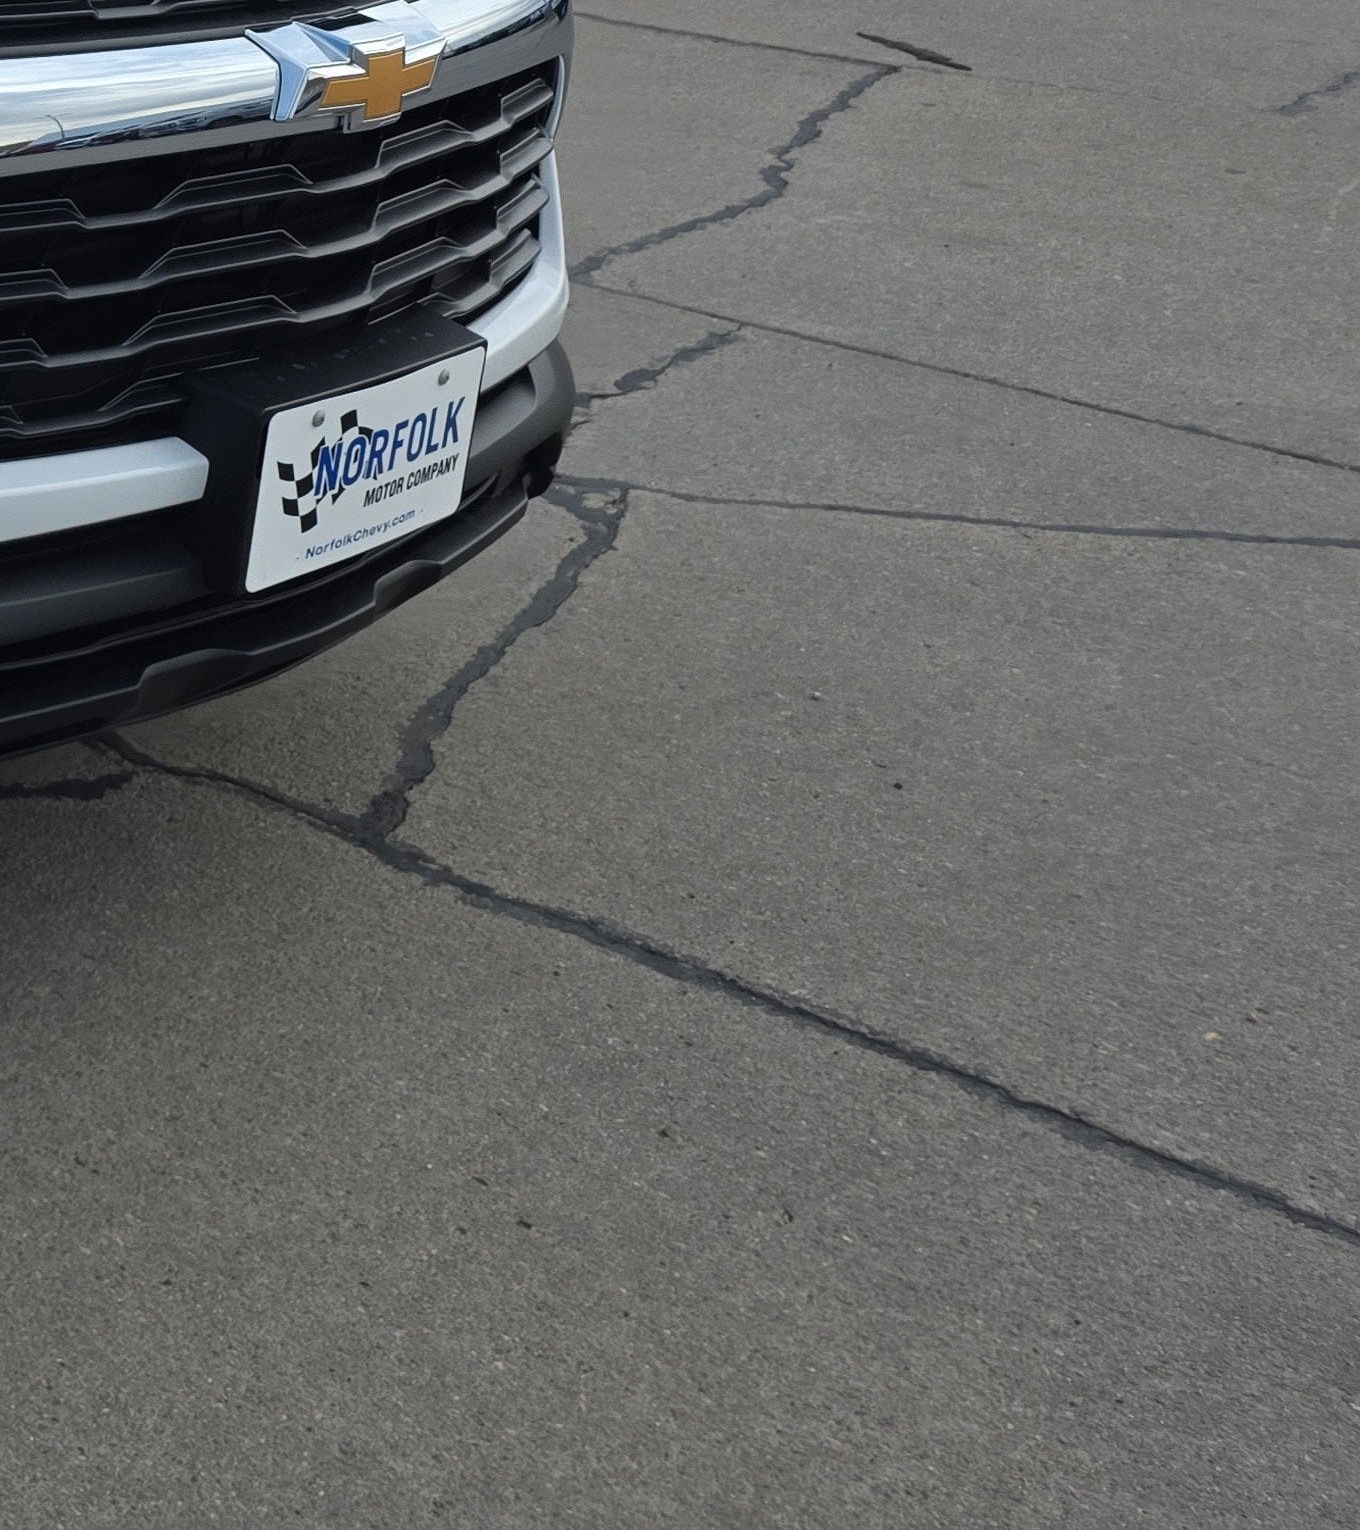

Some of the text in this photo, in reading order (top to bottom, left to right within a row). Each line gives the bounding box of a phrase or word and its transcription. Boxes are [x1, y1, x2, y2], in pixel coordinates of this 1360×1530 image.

[313, 395, 467, 497] NORFOLK
[363, 453, 460, 508] MOTOR COMPANY
[304, 508, 416, 560] NorfolkChevy.com
